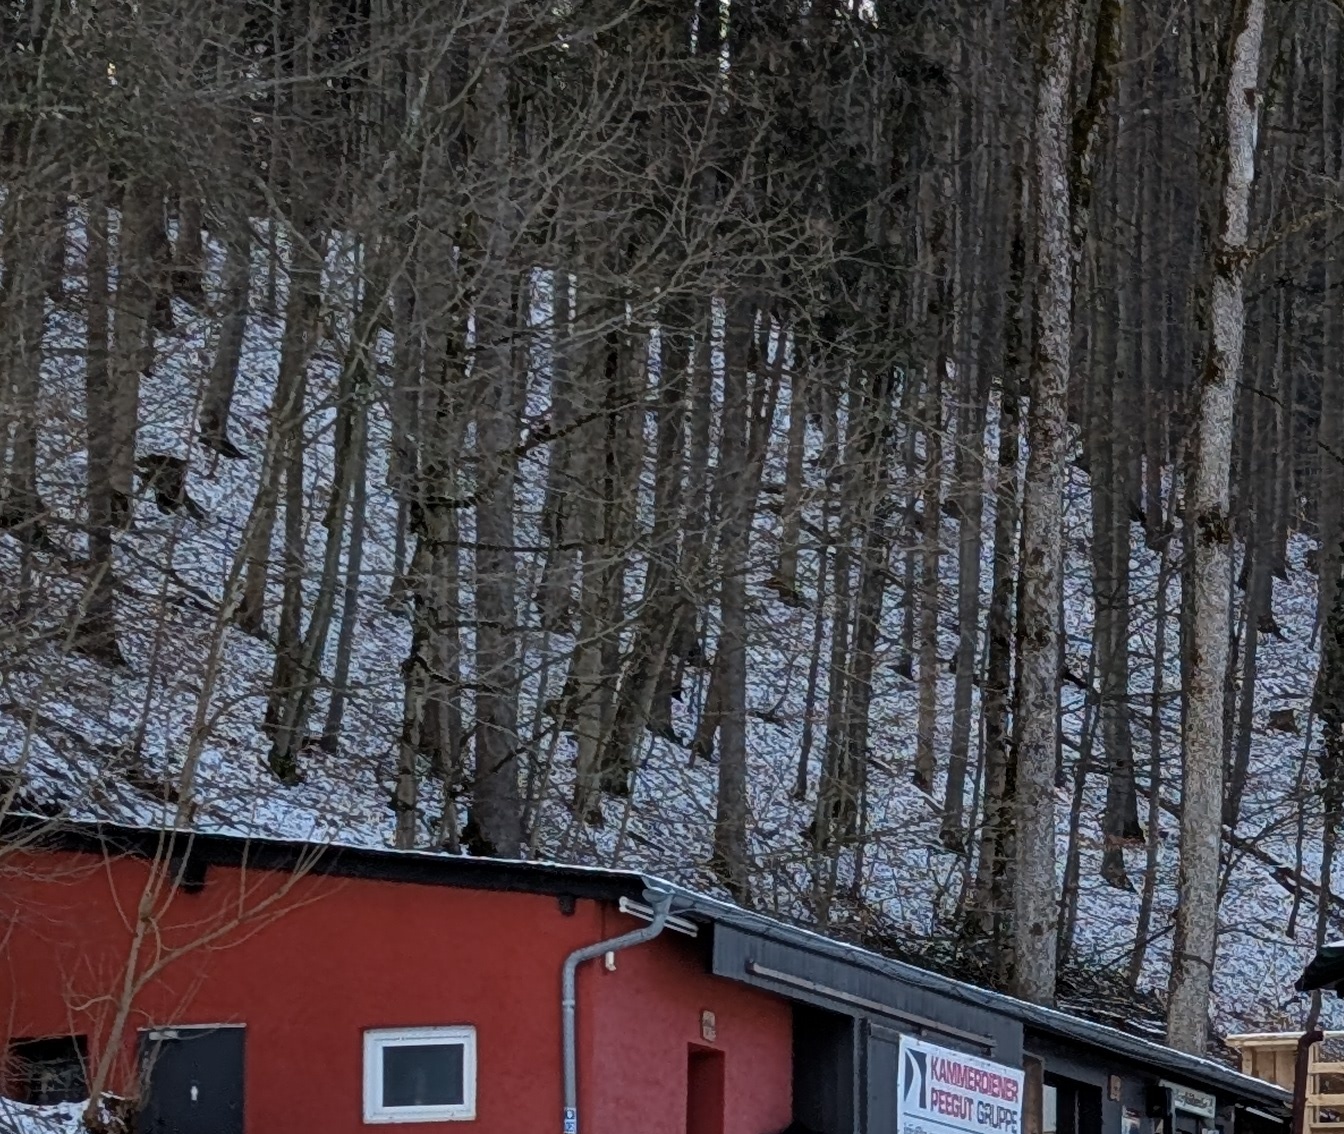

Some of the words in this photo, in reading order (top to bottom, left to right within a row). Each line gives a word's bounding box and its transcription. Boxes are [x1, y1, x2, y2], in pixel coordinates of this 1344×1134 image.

[930, 1056, 1019, 1103] KAMMERDIENER
[930, 1087, 974, 1121] PEEGUT
[976, 1101, 1018, 1134] GRUPPE
